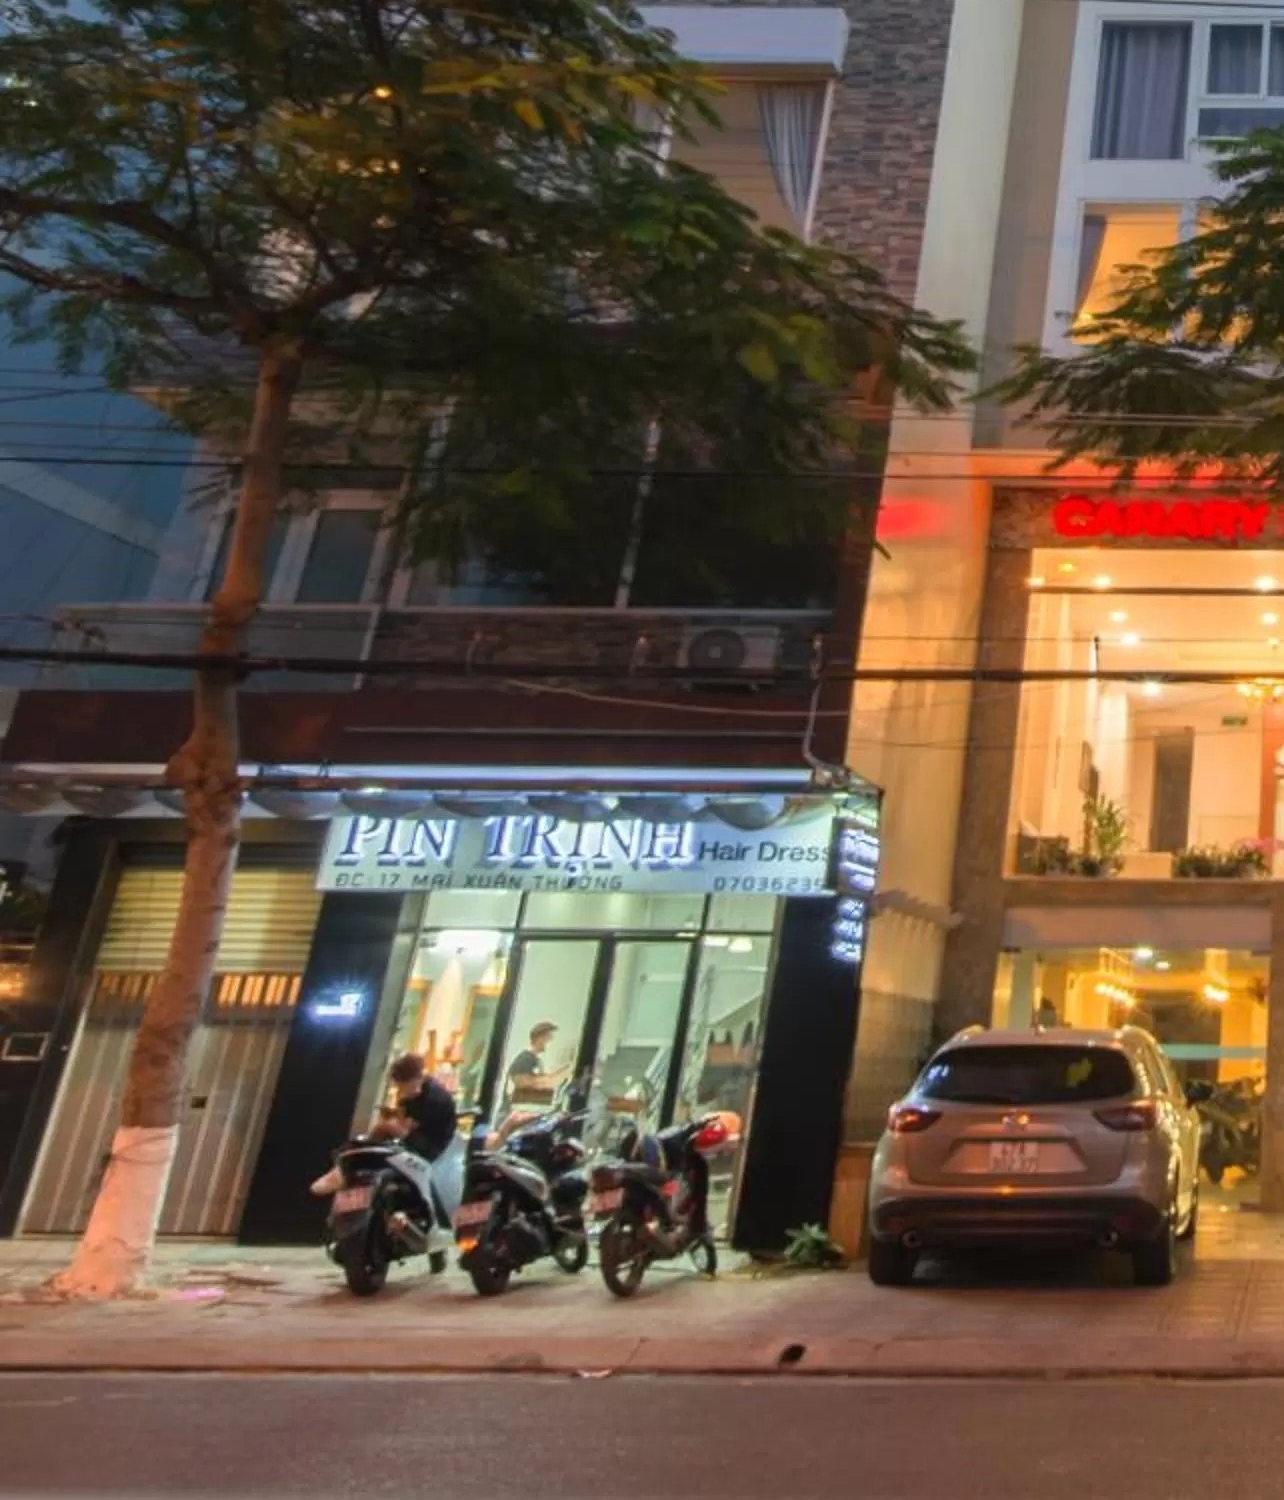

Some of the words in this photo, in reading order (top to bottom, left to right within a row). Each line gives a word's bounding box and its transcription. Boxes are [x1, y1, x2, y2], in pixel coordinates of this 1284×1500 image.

[1053, 496, 1269, 539] CANARY
[335, 815, 458, 866] PIN
[701, 841, 751, 862] Hair
[381, 873, 401, 887] 17
